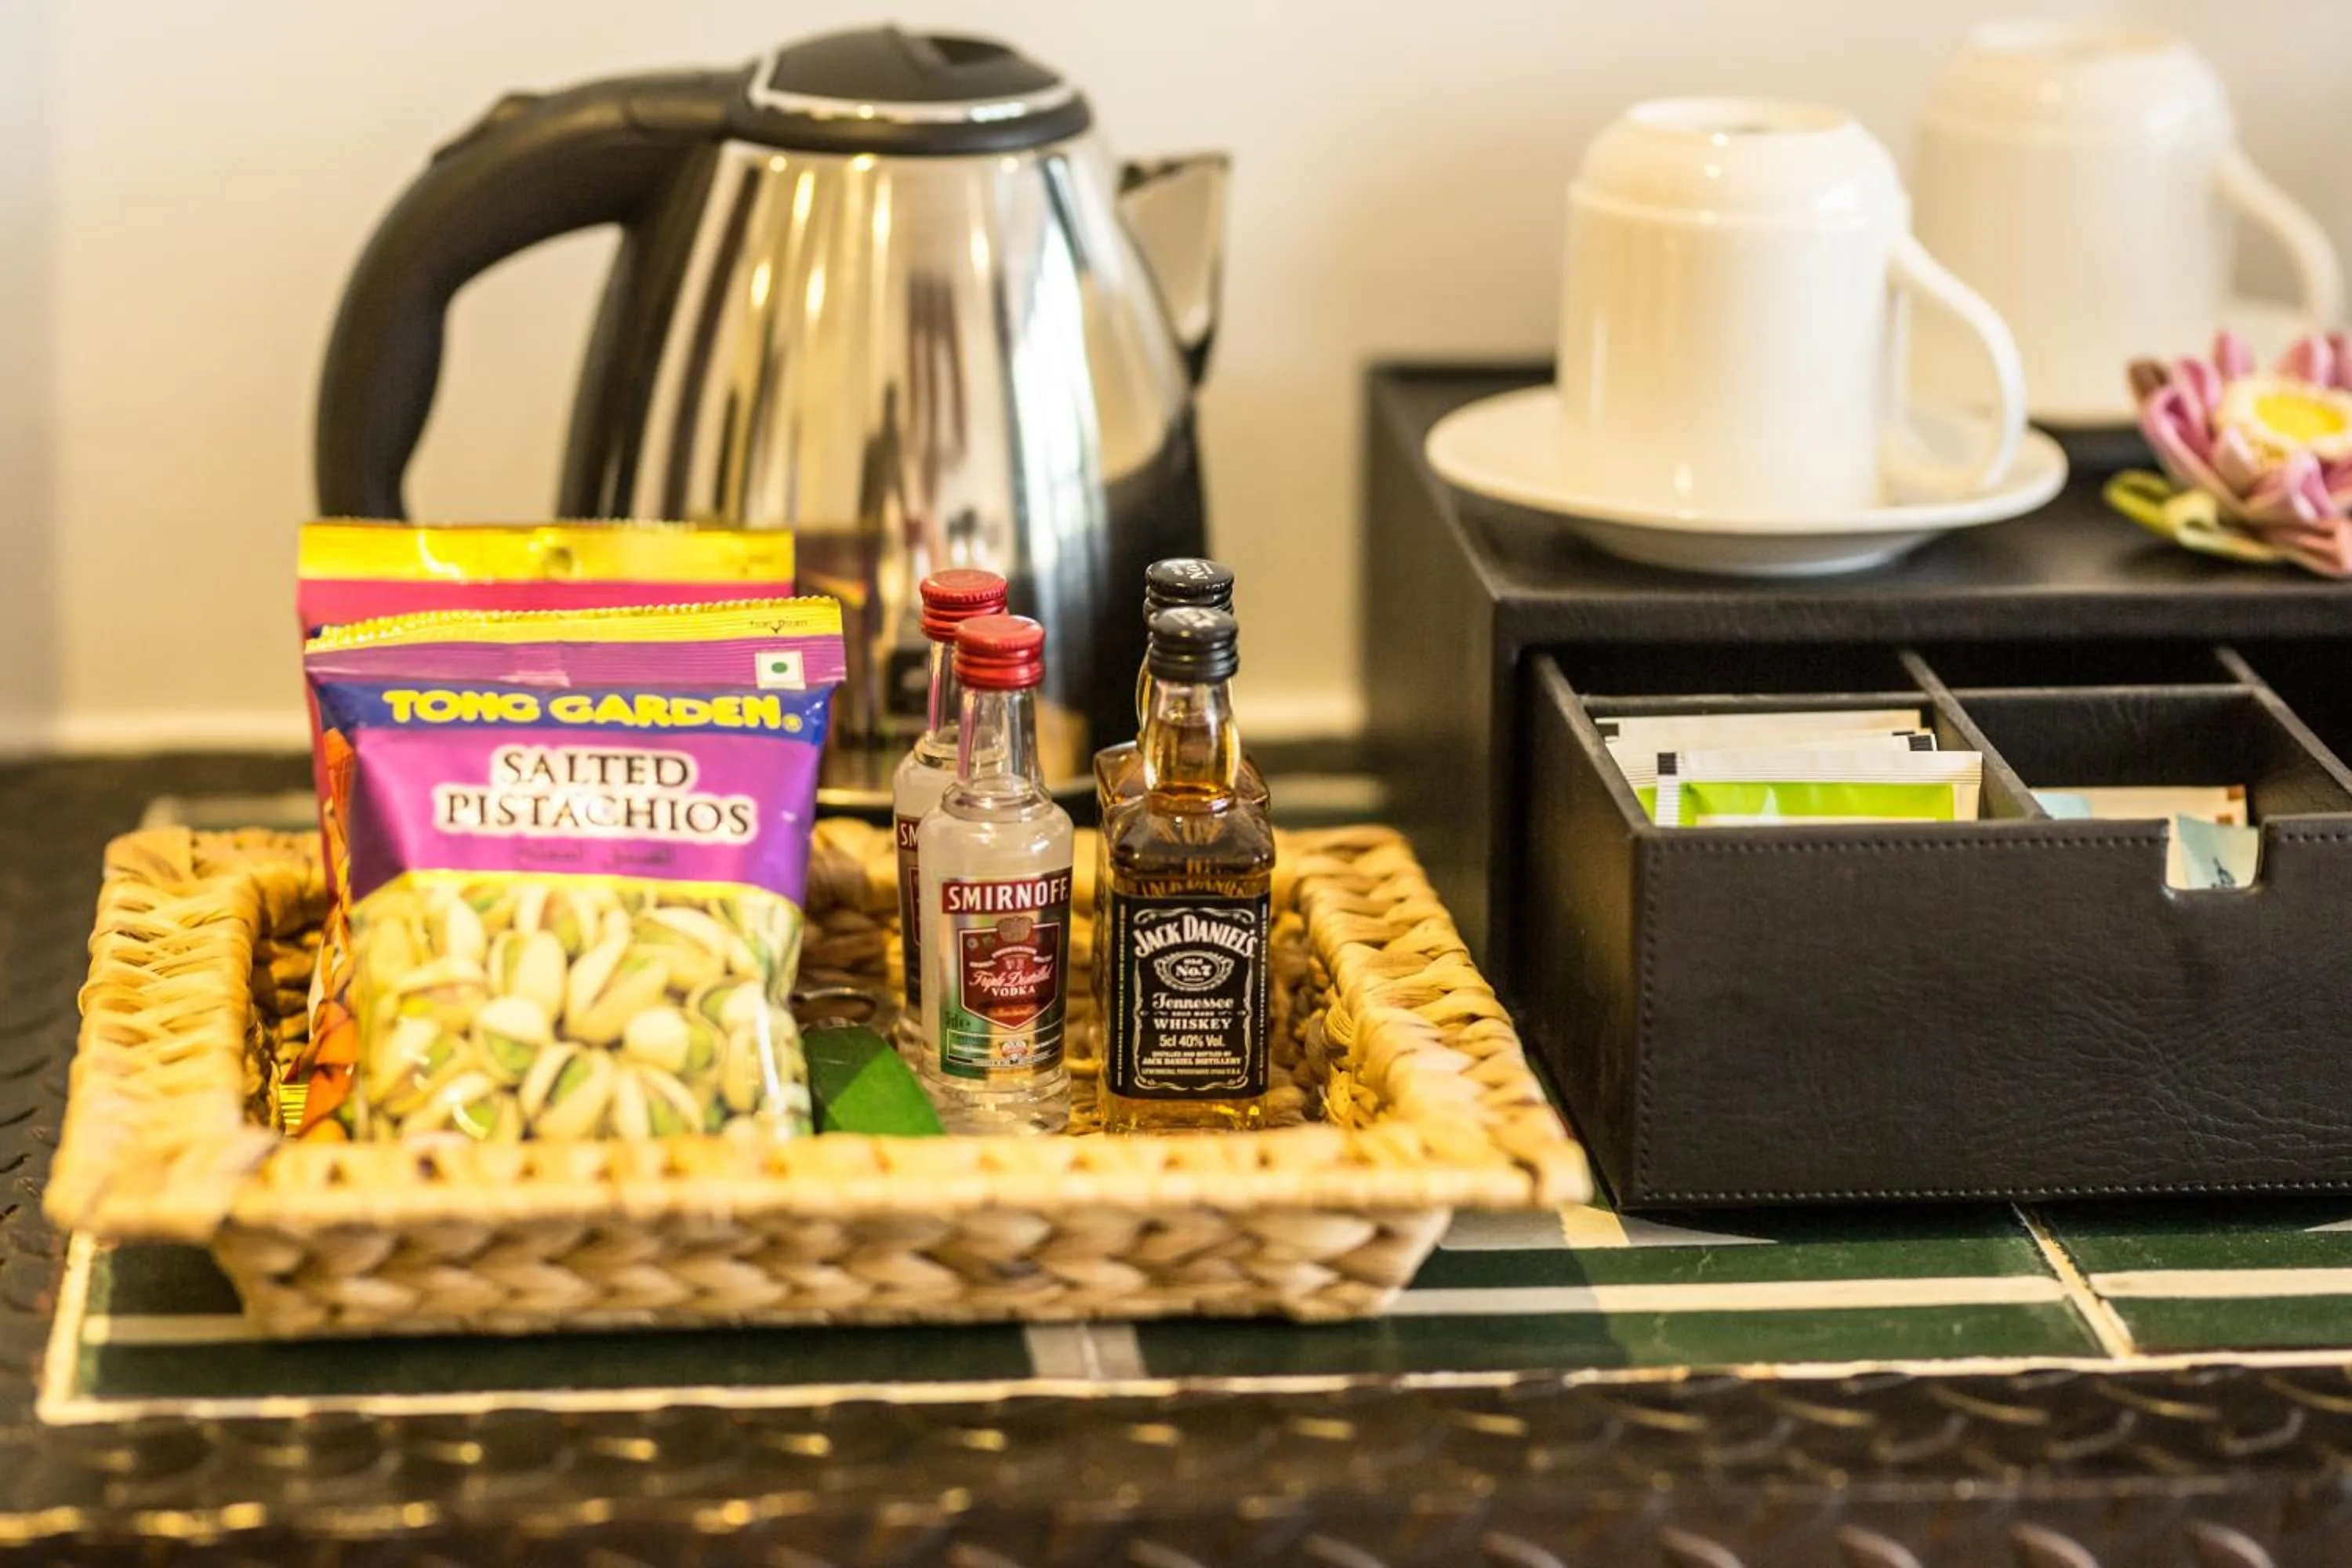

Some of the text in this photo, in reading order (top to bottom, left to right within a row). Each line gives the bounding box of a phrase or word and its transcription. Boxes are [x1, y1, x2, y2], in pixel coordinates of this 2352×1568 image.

[382, 689, 782, 730] TONG GARDEN
[503, 750, 690, 788] SALTED
[446, 792, 750, 836] PISTACHIOS
[948, 877, 1068, 911] SMIRNOFF
[991, 985, 1036, 996] VODKA
[1152, 992, 1234, 1010] Tennessee
[1153, 1018, 1232, 1030] WHISKEY
[1178, 1034, 1204, 1047] 40%
